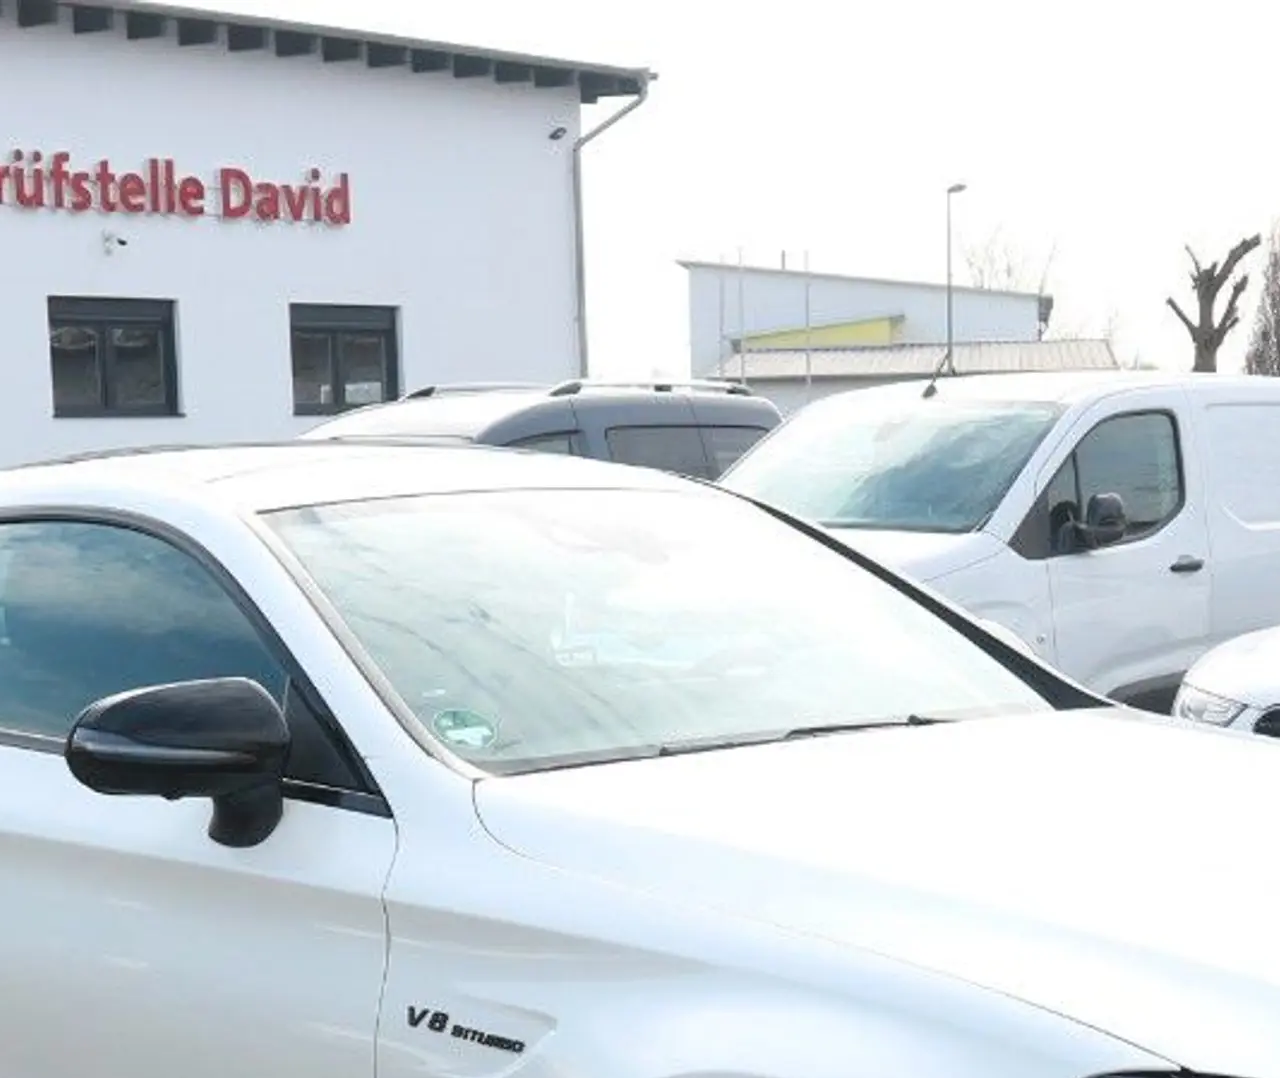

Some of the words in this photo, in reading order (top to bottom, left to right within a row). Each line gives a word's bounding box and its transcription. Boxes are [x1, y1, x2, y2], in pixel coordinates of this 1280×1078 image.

[220, 167, 351, 226] David
[407, 1005, 449, 1033] V8
[450, 1024, 526, 1053] BITURBO
